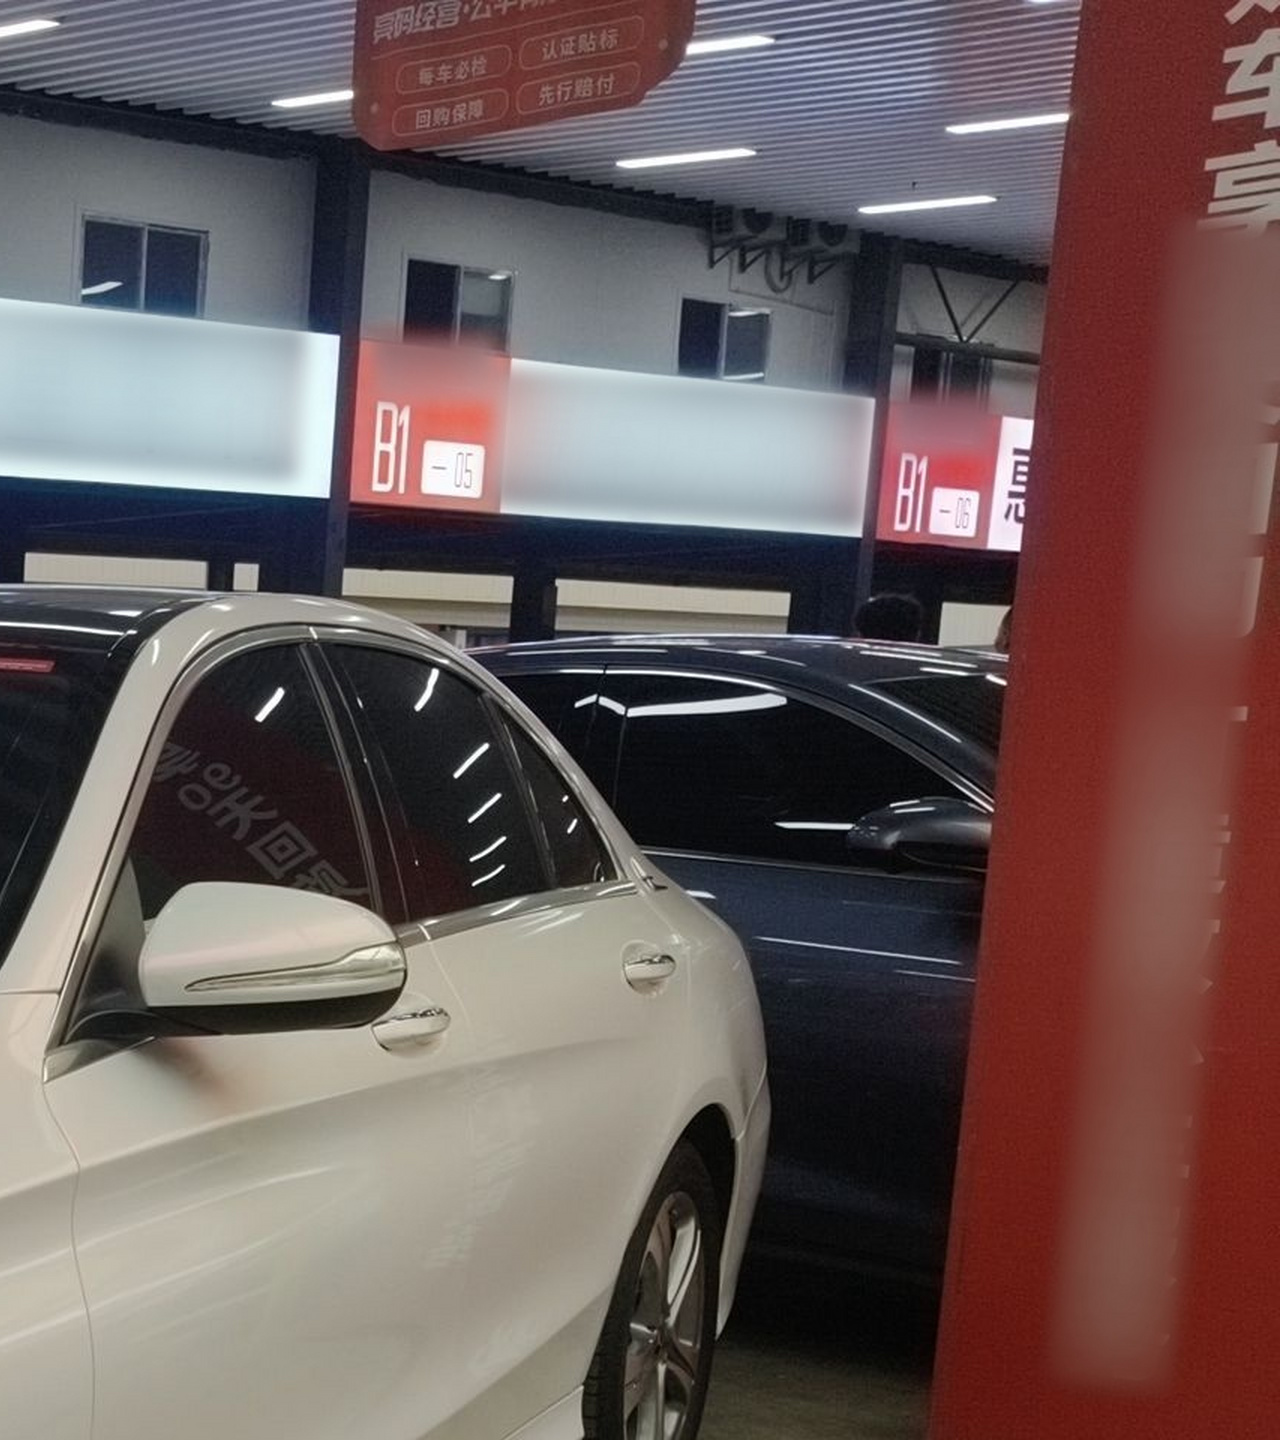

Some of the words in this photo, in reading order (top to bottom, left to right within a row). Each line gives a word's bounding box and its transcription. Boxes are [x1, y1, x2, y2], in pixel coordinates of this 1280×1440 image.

[543, 28, 619, 60] 认证贴标
[539, 73, 615, 106] 先行赔付
[416, 99, 484, 130] 回购保障
[371, 401, 410, 495] B1
[894, 452, 929, 533] B1
